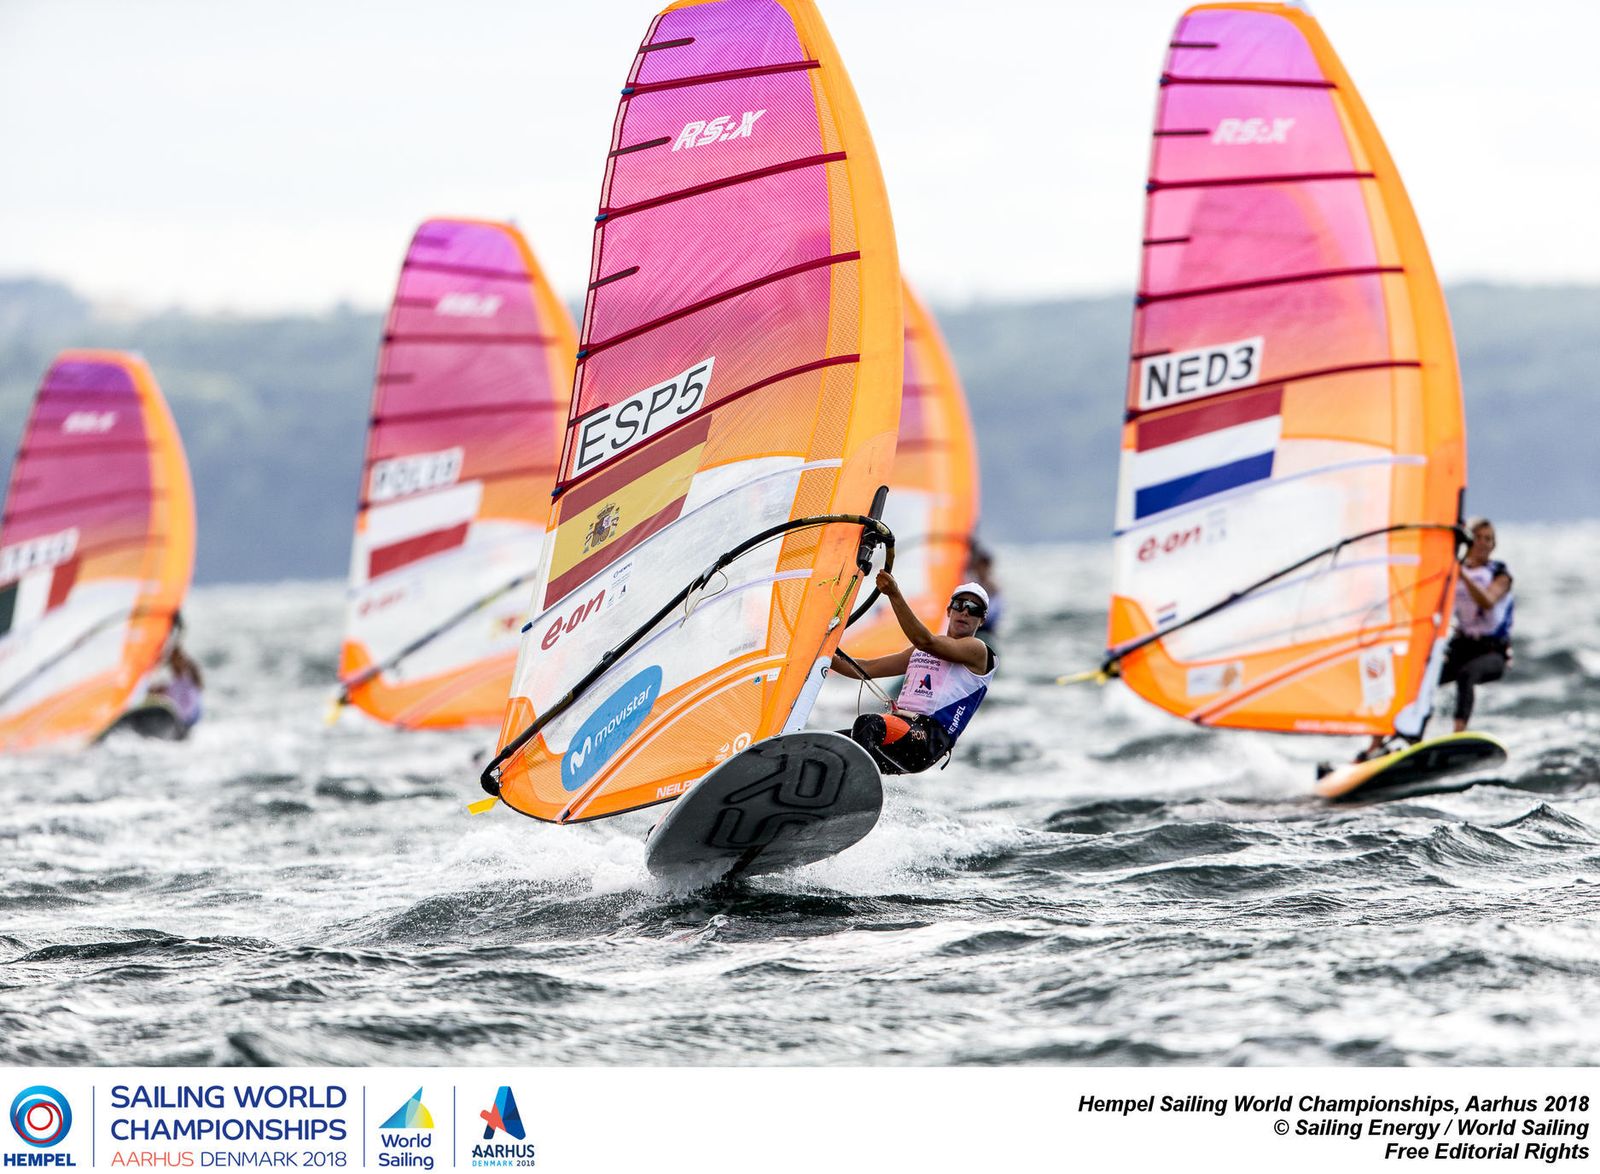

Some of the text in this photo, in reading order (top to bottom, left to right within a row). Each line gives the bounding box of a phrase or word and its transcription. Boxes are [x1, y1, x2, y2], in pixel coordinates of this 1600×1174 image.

[671, 108, 767, 152] RS:X
[1145, 345, 1256, 402] NED3
[577, 364, 708, 471] ESP5
[594, 682, 653, 748] movistar
